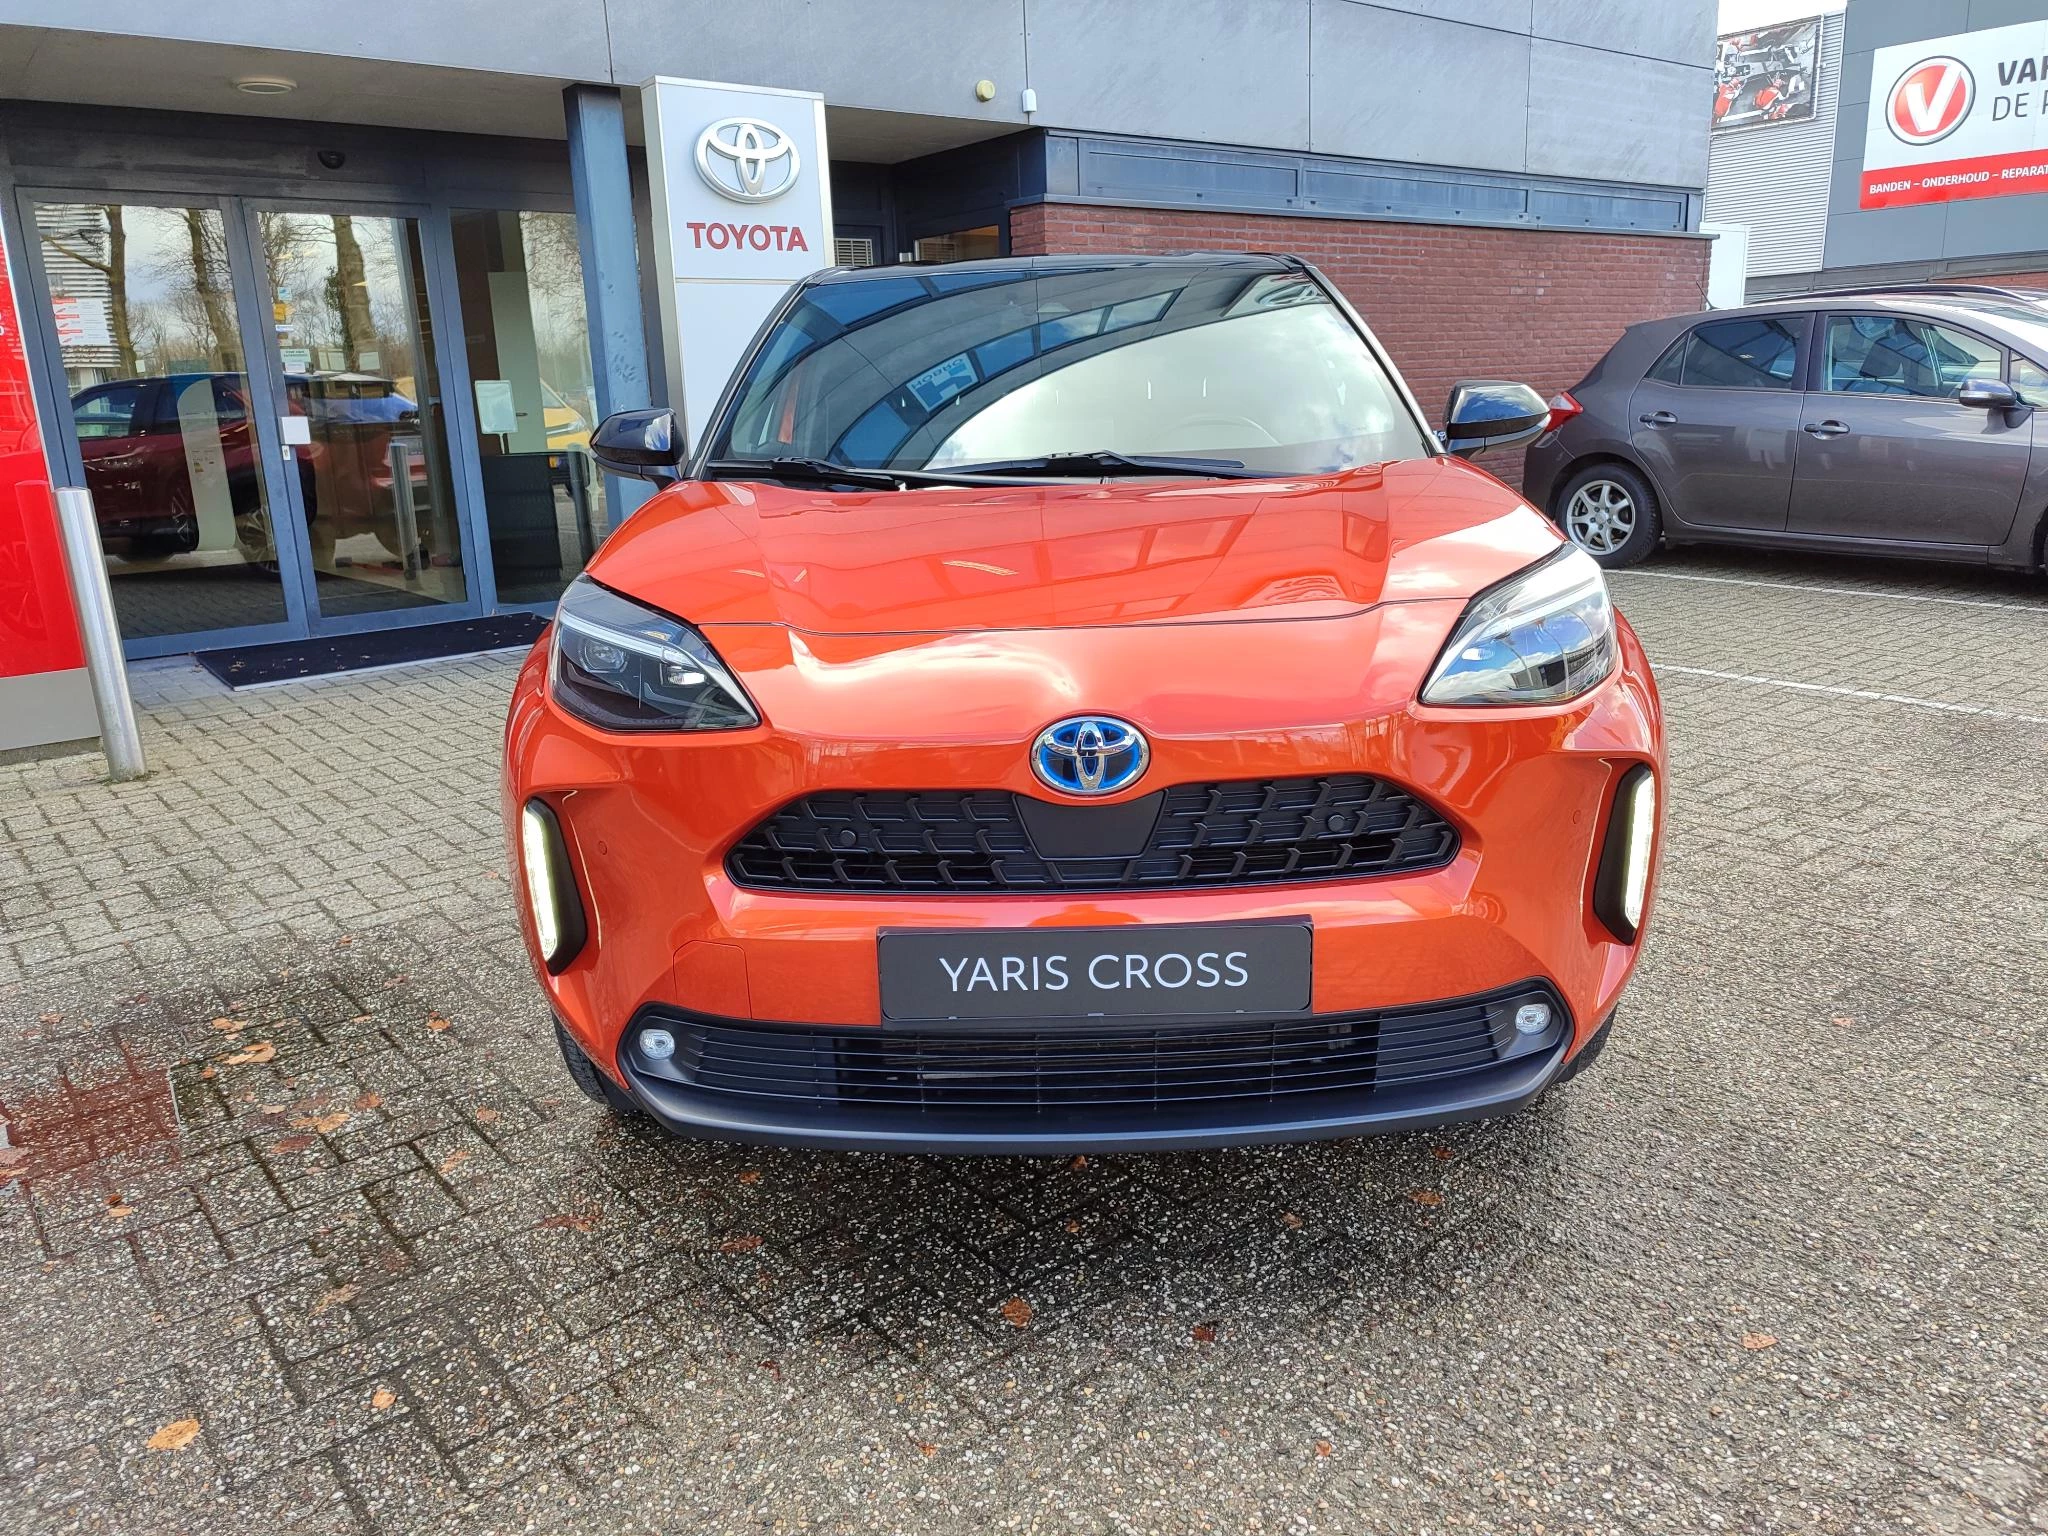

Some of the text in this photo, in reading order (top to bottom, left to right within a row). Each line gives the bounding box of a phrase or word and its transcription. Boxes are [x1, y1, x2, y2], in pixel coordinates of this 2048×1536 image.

[1992, 93, 2029, 121] DE
[1869, 180, 1911, 194] BANDEN
[1922, 171, 1990, 188] ONDERHOUD
[686, 222, 809, 252] TOYOTA
[938, 951, 1249, 992] YARIS CROSS
